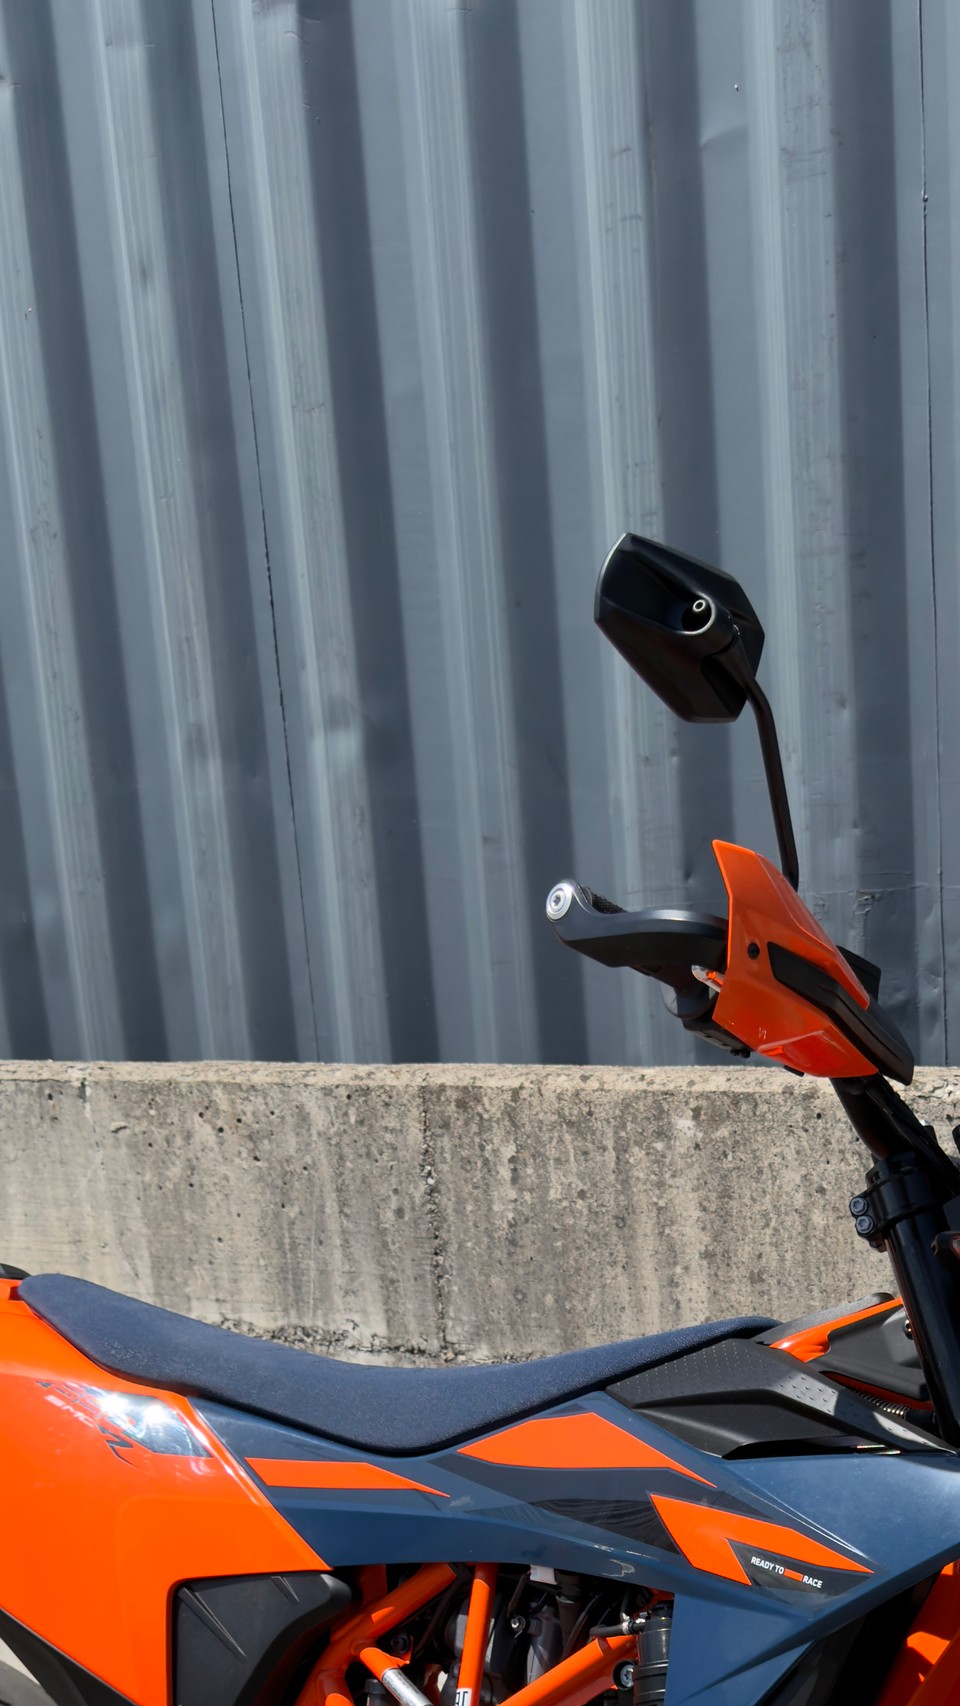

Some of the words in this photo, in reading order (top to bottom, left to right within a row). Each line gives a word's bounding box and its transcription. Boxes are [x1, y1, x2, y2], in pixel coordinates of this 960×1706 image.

[45, 1395, 95, 1428] SMC
[751, 1556, 775, 1570] READY
[775, 1564, 784, 1575] TO
[802, 1575, 823, 1588] RACE
